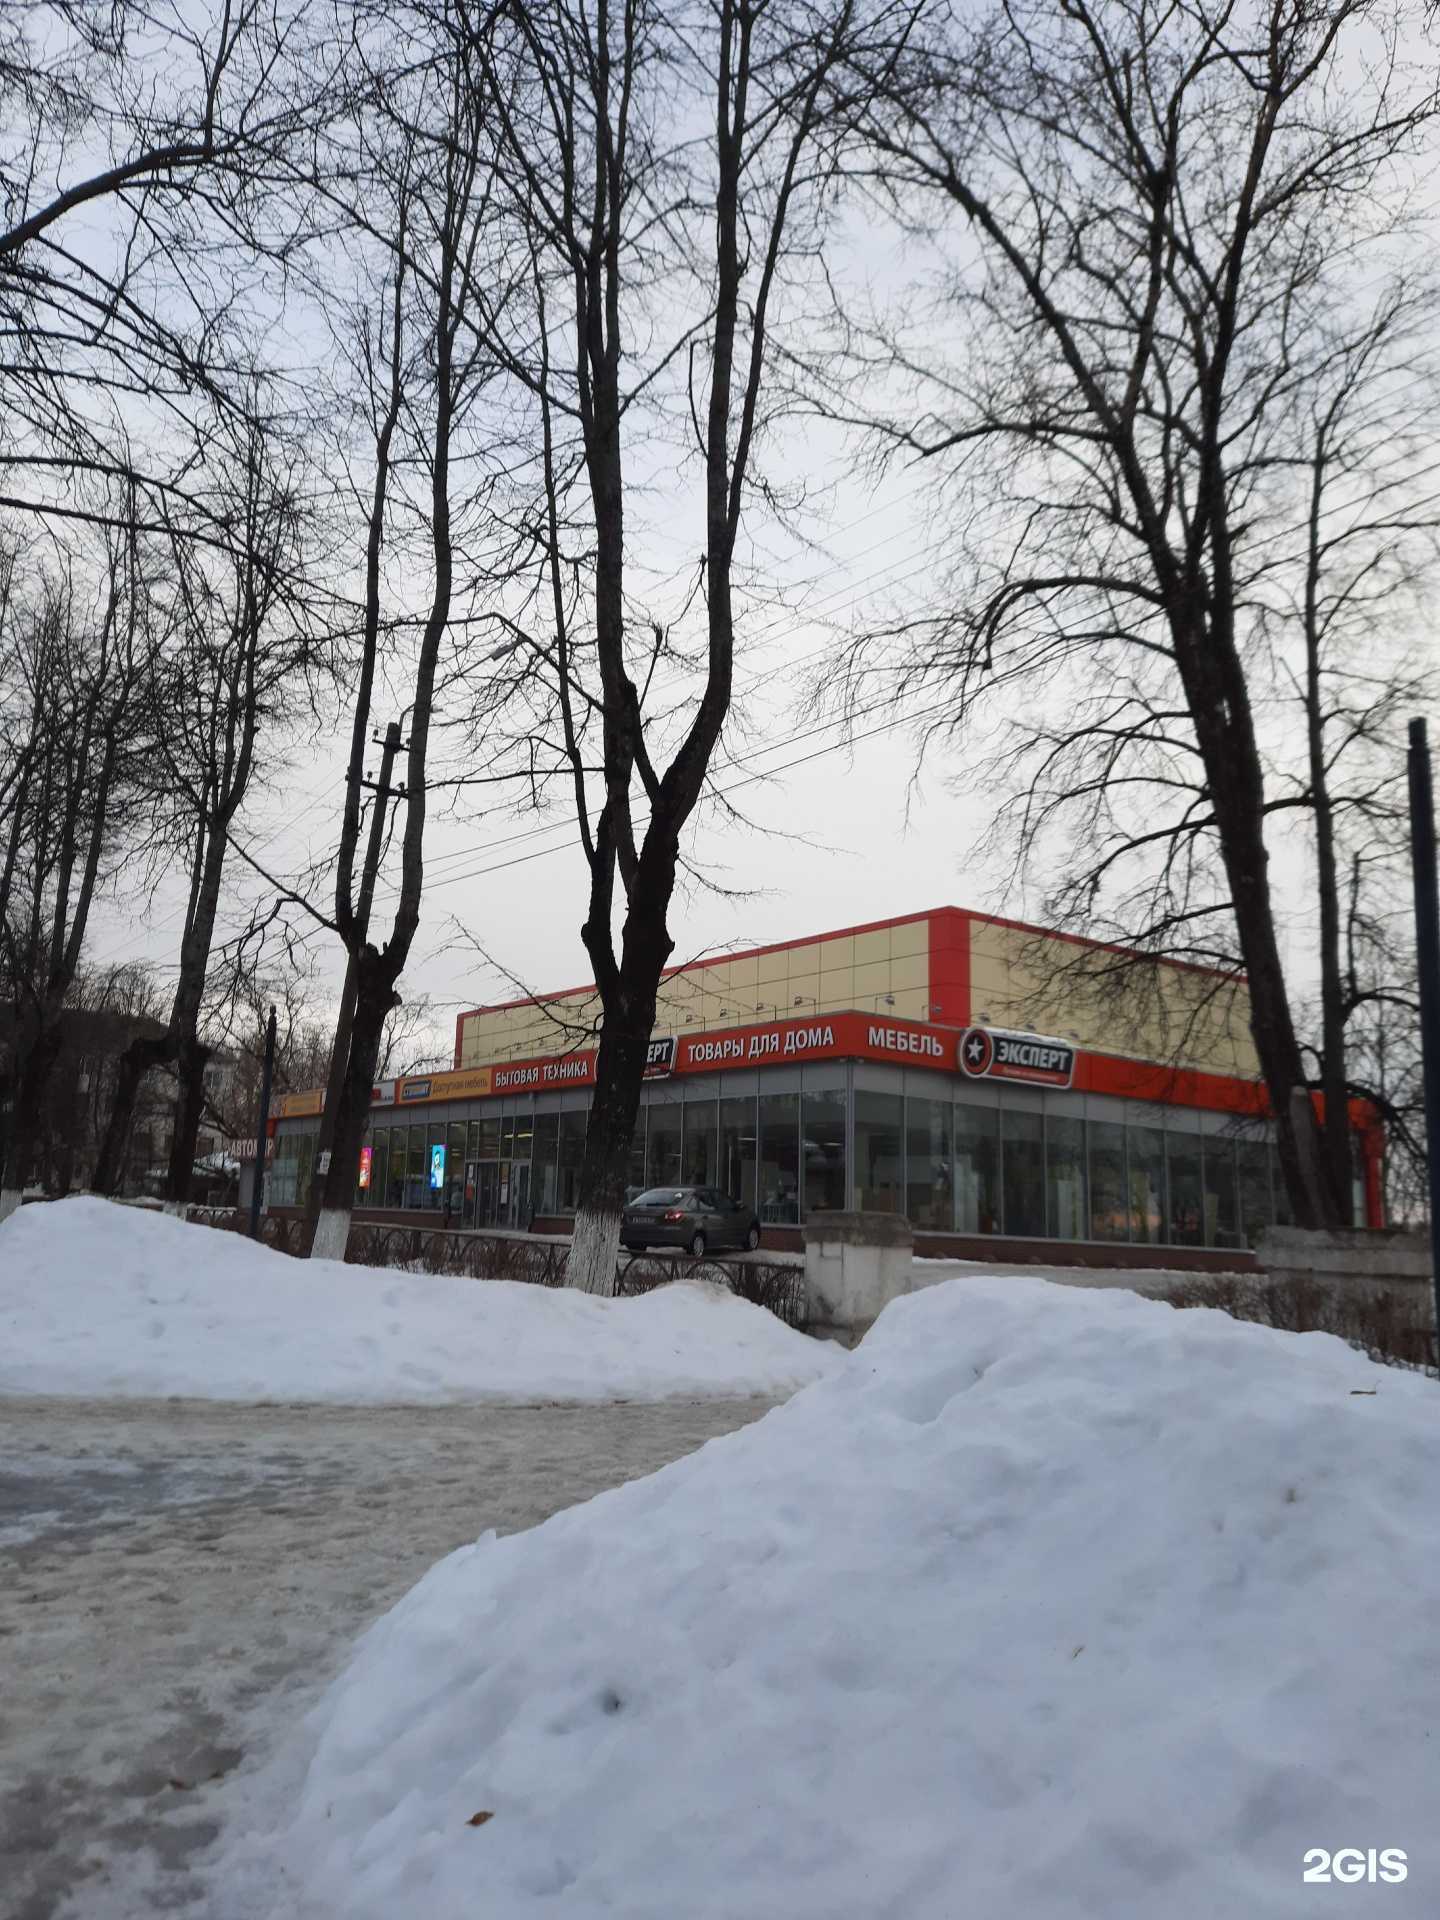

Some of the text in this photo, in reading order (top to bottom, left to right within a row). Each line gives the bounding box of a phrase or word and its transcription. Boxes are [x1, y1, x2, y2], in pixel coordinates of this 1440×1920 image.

[688, 1037, 744, 1063] ТОВАРЫ
[748, 1032, 780, 1058] ДЛЯ
[784, 1025, 834, 1054] ДОМА
[868, 1026, 944, 1057] МЕБЕЛЬ
[997, 1041, 1070, 1071] ЭКСПЕРТ
[495, 1060, 588, 1087] БЫТОВАЯ ТЕХНИКА
